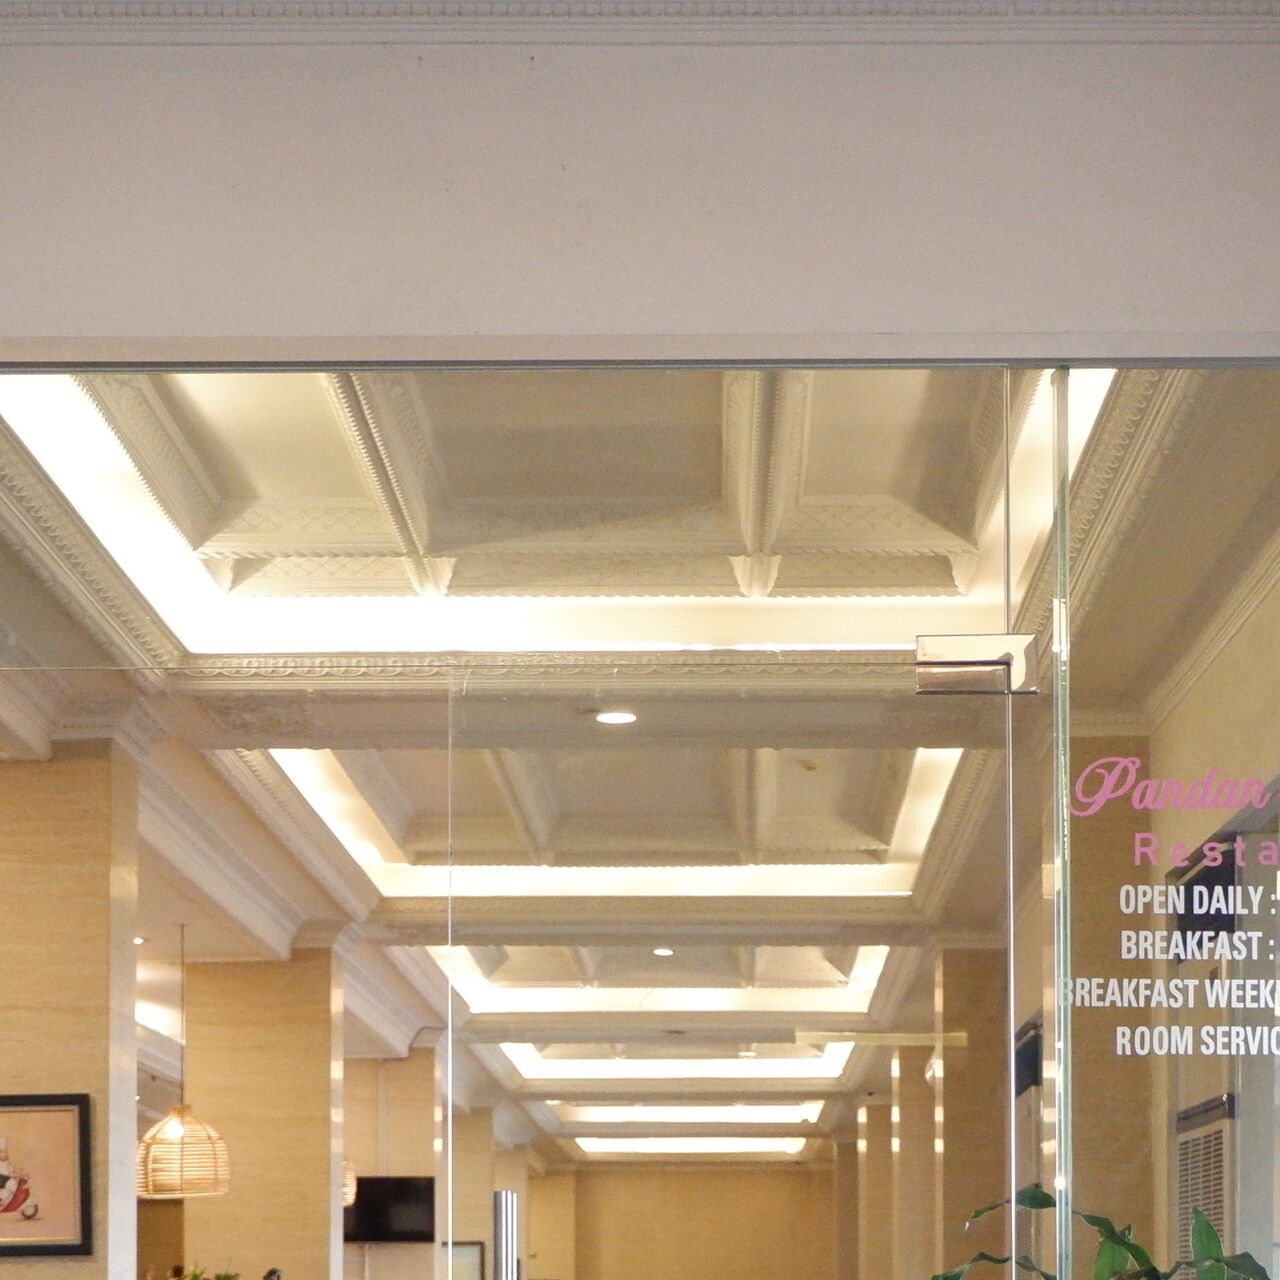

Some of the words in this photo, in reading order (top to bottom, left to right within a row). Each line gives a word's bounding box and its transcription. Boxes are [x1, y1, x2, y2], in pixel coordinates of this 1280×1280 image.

[1069, 757, 1276, 816] Pandan
[1119, 885, 1185, 914] OPEN
[1193, 885, 1264, 915] DAILY
[1121, 930, 1263, 960] BREAKFAST
[1116, 1026, 1193, 1056] ROOM
